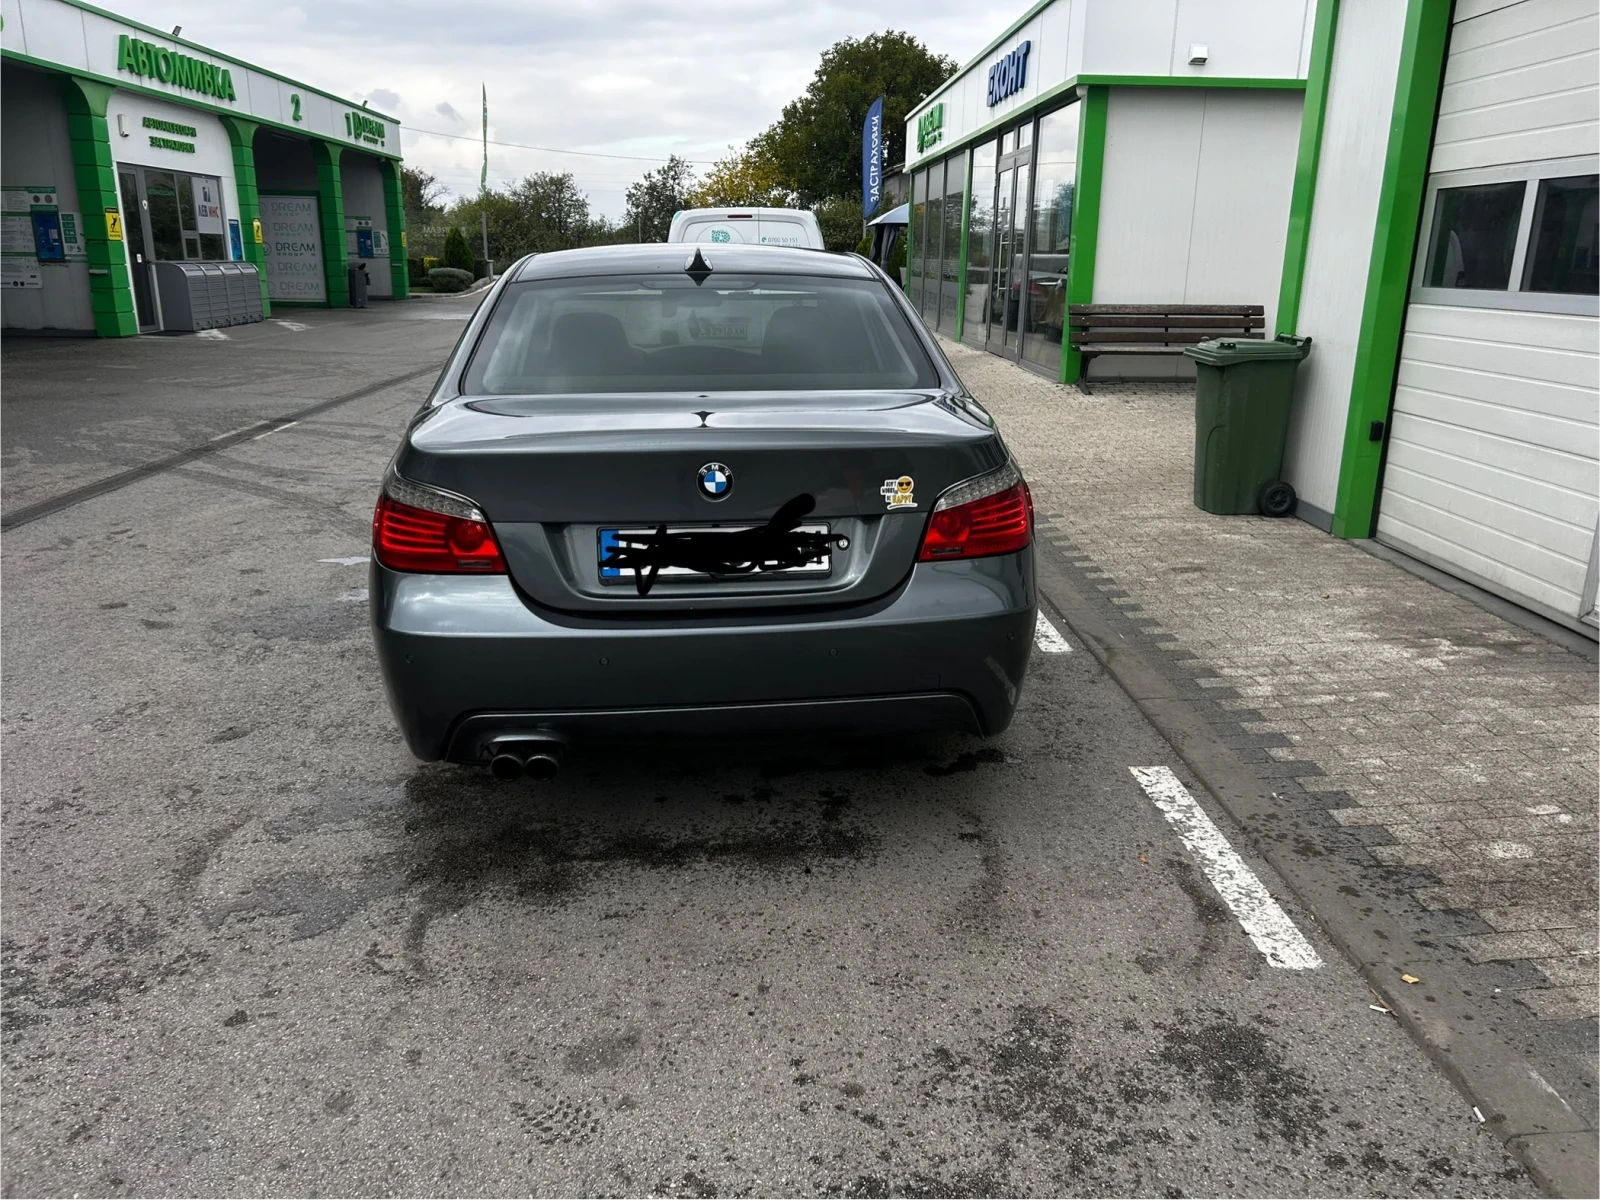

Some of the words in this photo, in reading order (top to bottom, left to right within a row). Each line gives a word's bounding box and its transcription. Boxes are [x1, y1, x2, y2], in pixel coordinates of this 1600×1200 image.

[117, 34, 236, 101] АВТОМИВКА
[986, 40, 1031, 107] ЕКОНТ
[291, 93, 302, 121] 2
[344, 112, 352, 137] 1
[869, 115, 880, 202] ЗАСТРАХОВКИ
[275, 242, 316, 252] DREAM
[700, 464, 731, 476] BMW
